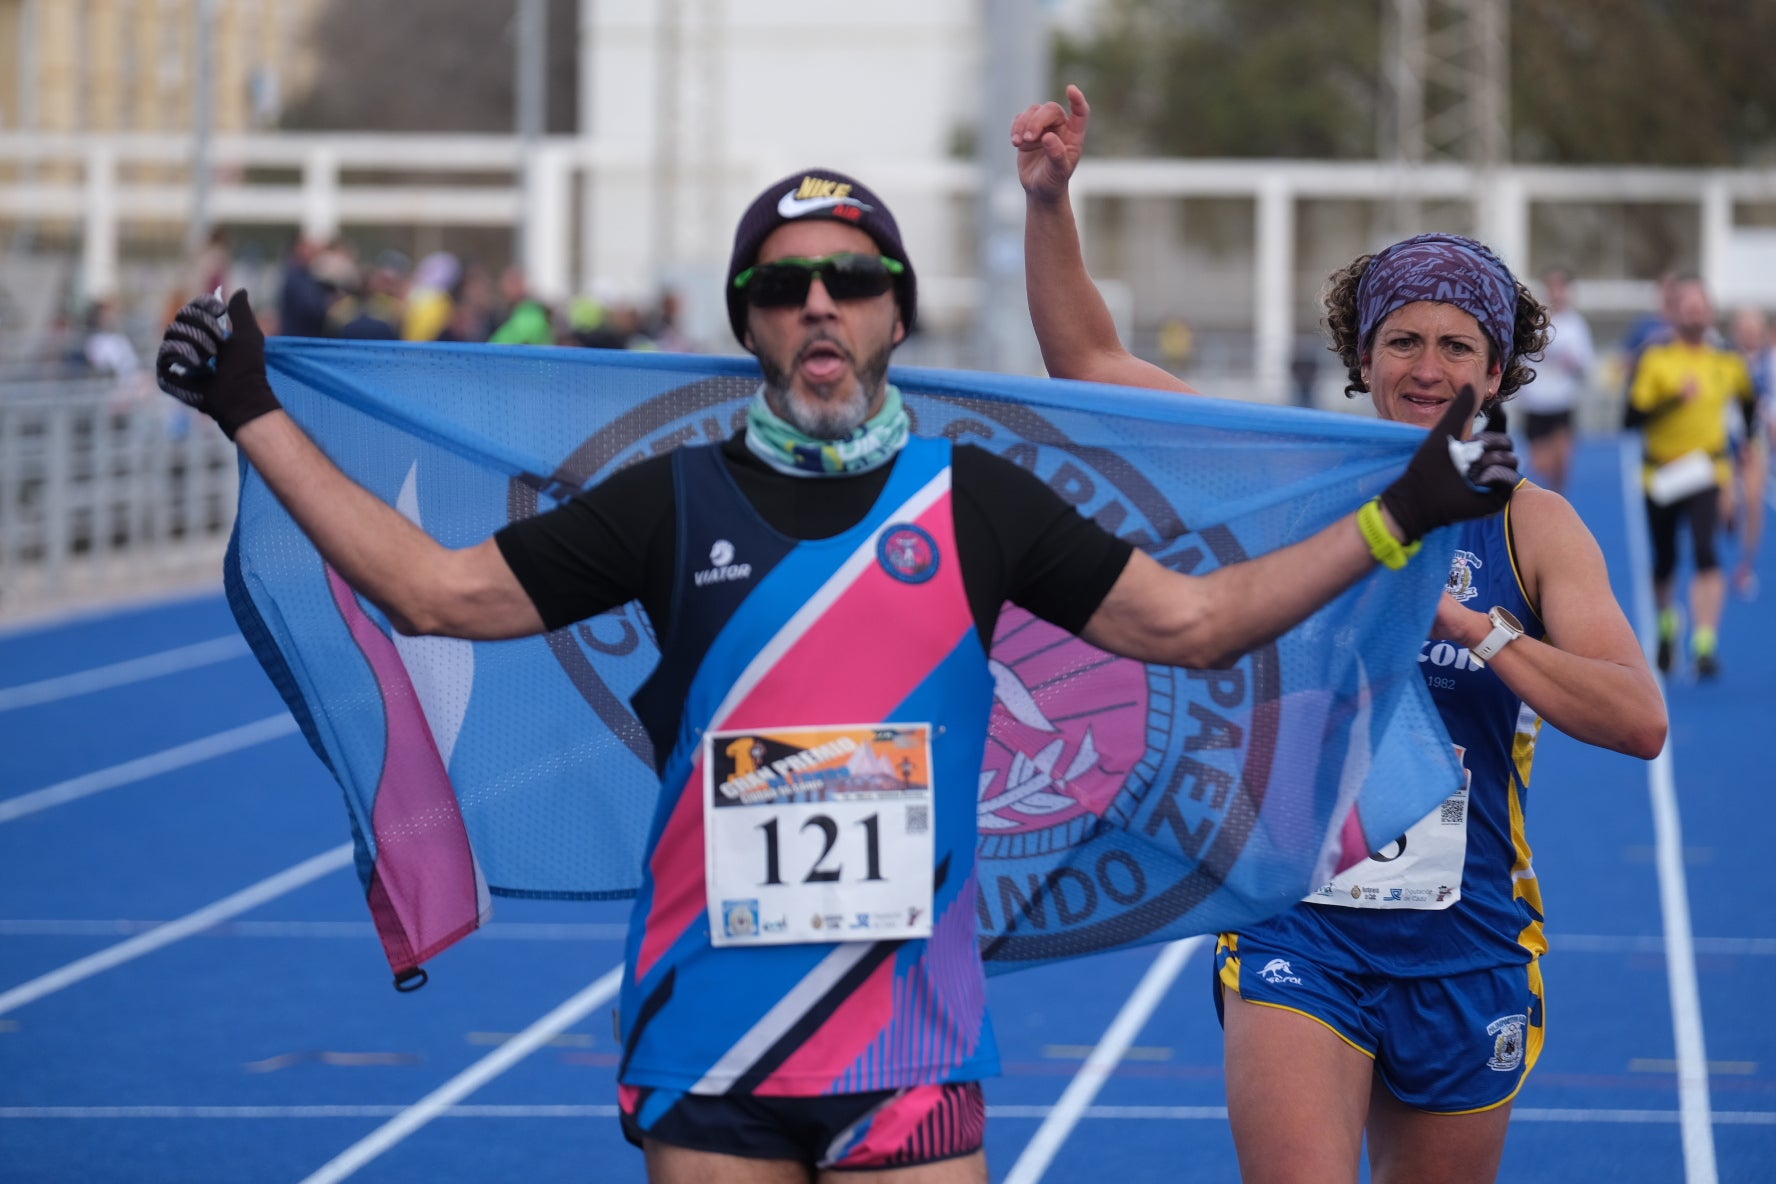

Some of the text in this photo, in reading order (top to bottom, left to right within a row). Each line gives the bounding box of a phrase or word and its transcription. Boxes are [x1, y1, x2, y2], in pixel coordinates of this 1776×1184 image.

[796, 175, 853, 200] NIKE
[694, 563, 752, 586] VIATOR
[1428, 675, 1456, 690] 1982
[771, 736, 857, 777] PREMIO
[754, 812, 889, 887] 121
